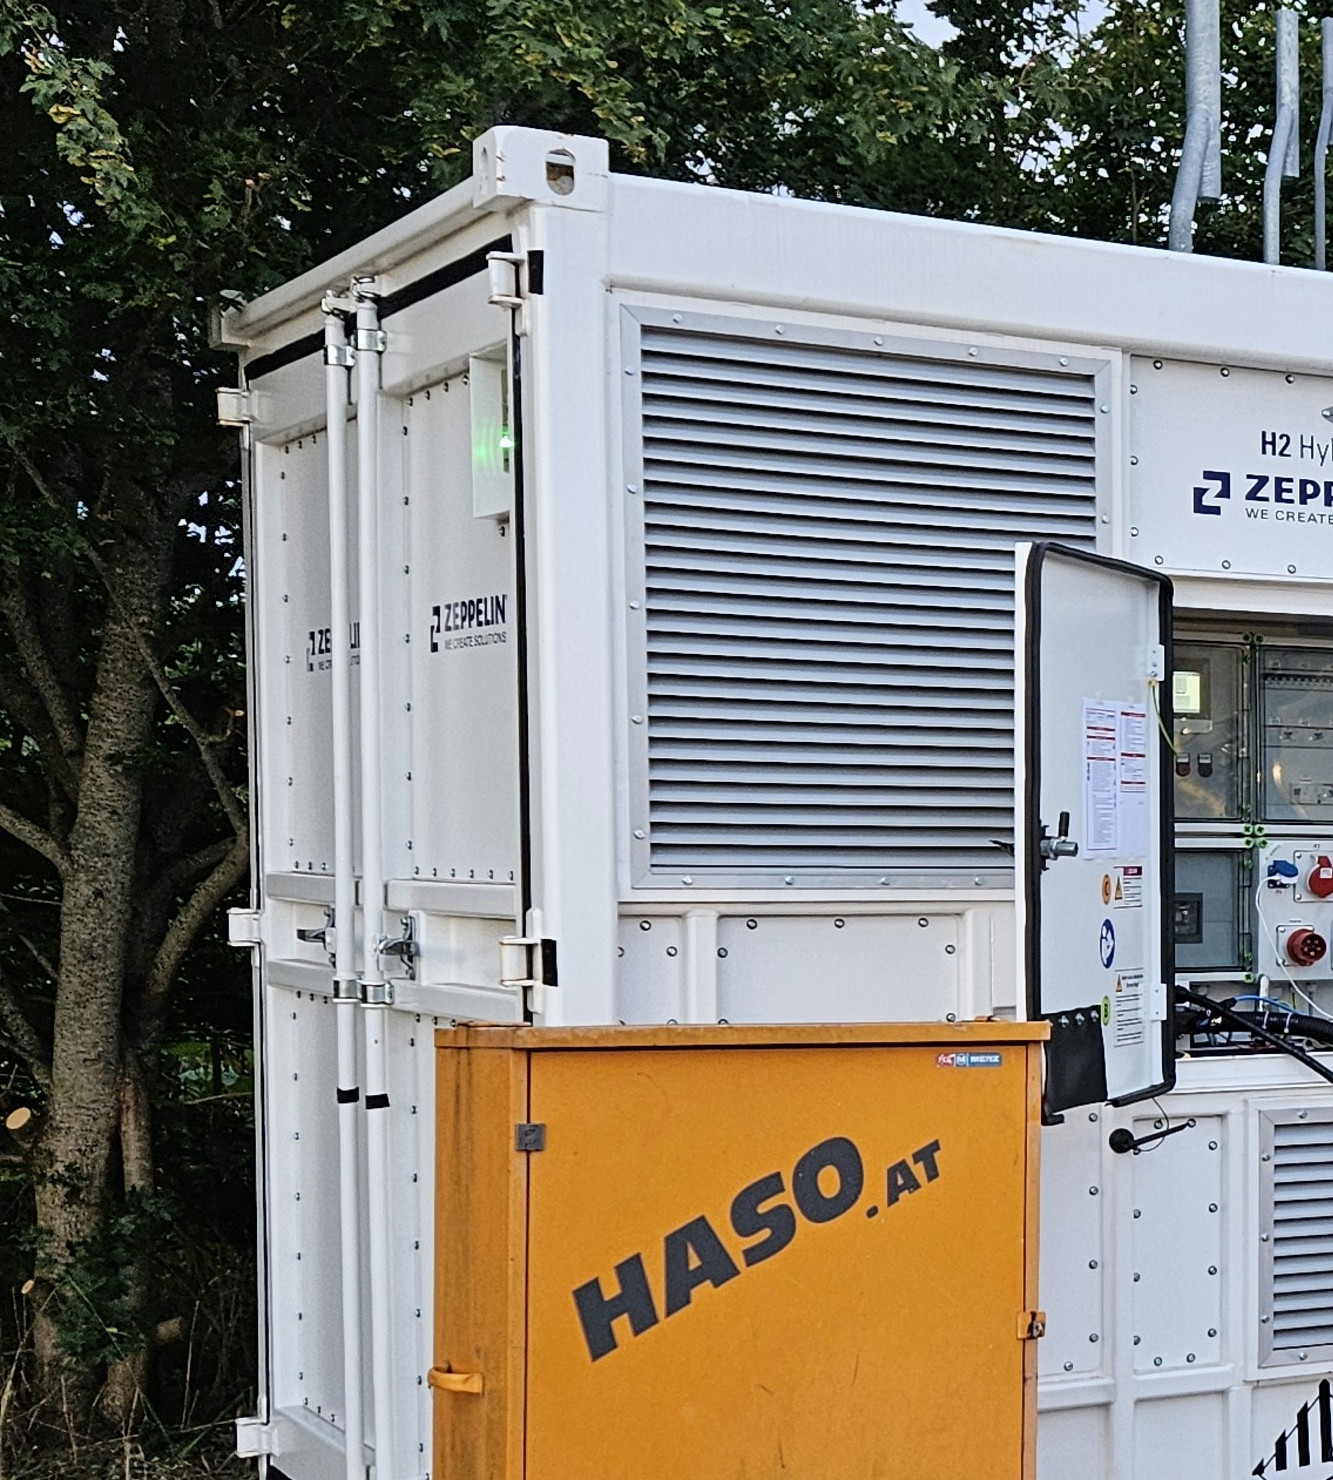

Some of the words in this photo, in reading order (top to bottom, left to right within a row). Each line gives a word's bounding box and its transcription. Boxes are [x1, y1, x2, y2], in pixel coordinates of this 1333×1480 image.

[1261, 430, 1292, 457] H2
[1245, 507, 1269, 520] WE
[444, 594, 506, 632] ZEPPELIN
[318, 622, 360, 655] ZELI
